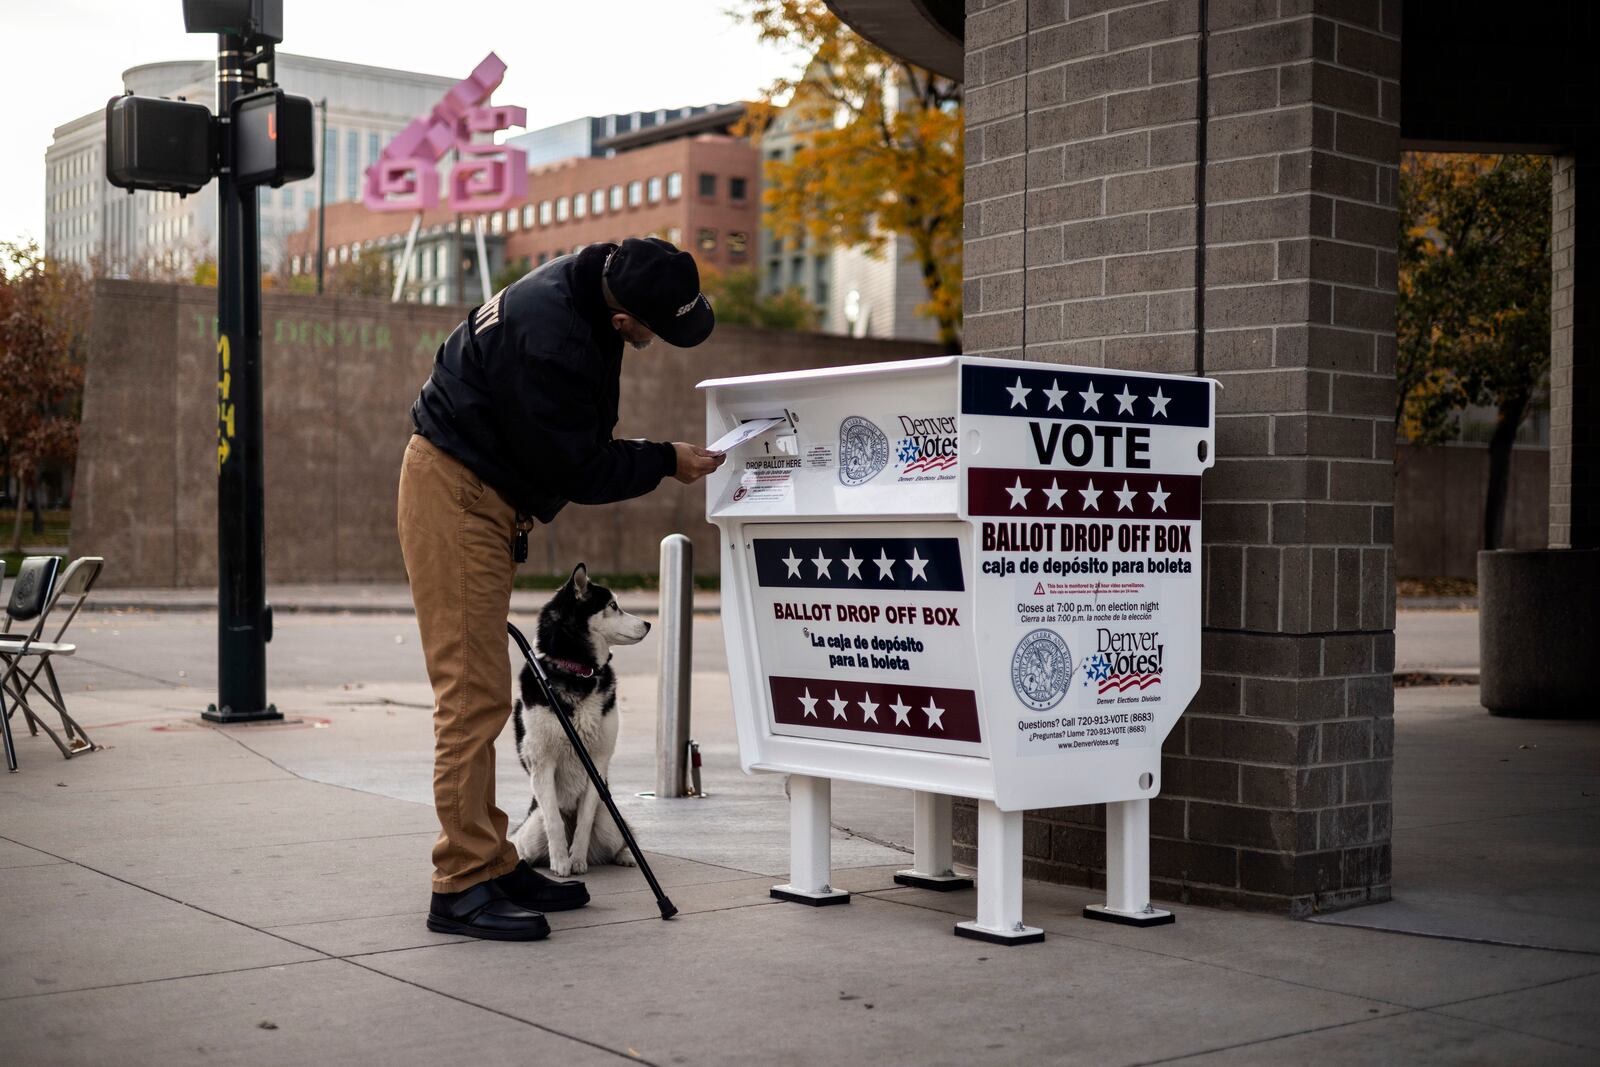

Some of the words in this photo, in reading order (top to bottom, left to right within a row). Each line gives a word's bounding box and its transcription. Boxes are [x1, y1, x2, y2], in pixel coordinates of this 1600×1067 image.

[273, 318, 393, 351] DENVER
[898, 415, 958, 436] Denver
[1029, 421, 1151, 469] VOTE
[745, 460, 763, 470] DROP
[763, 459, 785, 469] BALLOT
[786, 458, 802, 468] HERE
[982, 522, 1057, 551] BALLOT
[1060, 523, 1114, 552] DROP
[1118, 524, 1150, 552] OFF
[1154, 525, 1192, 553] BOX
[982, 557, 1015, 577] caja
[1020, 557, 1039, 574] de
[1043, 556, 1108, 577] depósito
[1112, 561, 1144, 577] para
[1147, 557, 1192, 574] boleta
[773, 602, 832, 621] BALLOT
[836, 604, 880, 622] DROP
[885, 605, 917, 625] OFF
[922, 607, 961, 626] BOX
[1017, 603, 1044, 613] Closes
[1046, 603, 1055, 613] at
[1057, 602, 1075, 612] 7:00
[1077, 604, 1095, 614] p.m.
[1096, 603, 1106, 612] on
[1108, 601, 1138, 612] election
[1140, 601, 1160, 613] night
[1021, 615, 1040, 623] Cierra
[1057, 614, 1071, 622] 7:00
[1072, 615, 1085, 623] p.m.
[1112, 613, 1120, 621] de
[1121, 613, 1127, 621] la
[1128, 612, 1152, 620] elección
[810, 633, 825, 648] La
[827, 634, 851, 652] caja
[854, 635, 868, 650] de
[871, 635, 924, 654] depósito
[1096, 628, 1159, 653] Denver
[829, 653, 855, 669] para
[858, 653, 869, 668] la
[871, 654, 910, 671] boleta
[1105, 644, 1164, 676] Votes!
[1141, 695, 1162, 703] Division
[1018, 718, 1060, 731] Questions?
[1061, 717, 1076, 727] Call
[1077, 713, 1129, 726] 720-913-VOTE
[1130, 712, 1155, 724] (8683)
[1029, 730, 1066, 742] ¿Preguntas?
[1067, 730, 1085, 738] Llame
[1086, 726, 1126, 736] 720-913-VOTE
[1127, 725, 1147, 735] (8683)
[1058, 738, 1120, 749] www.DenverVotes.org
